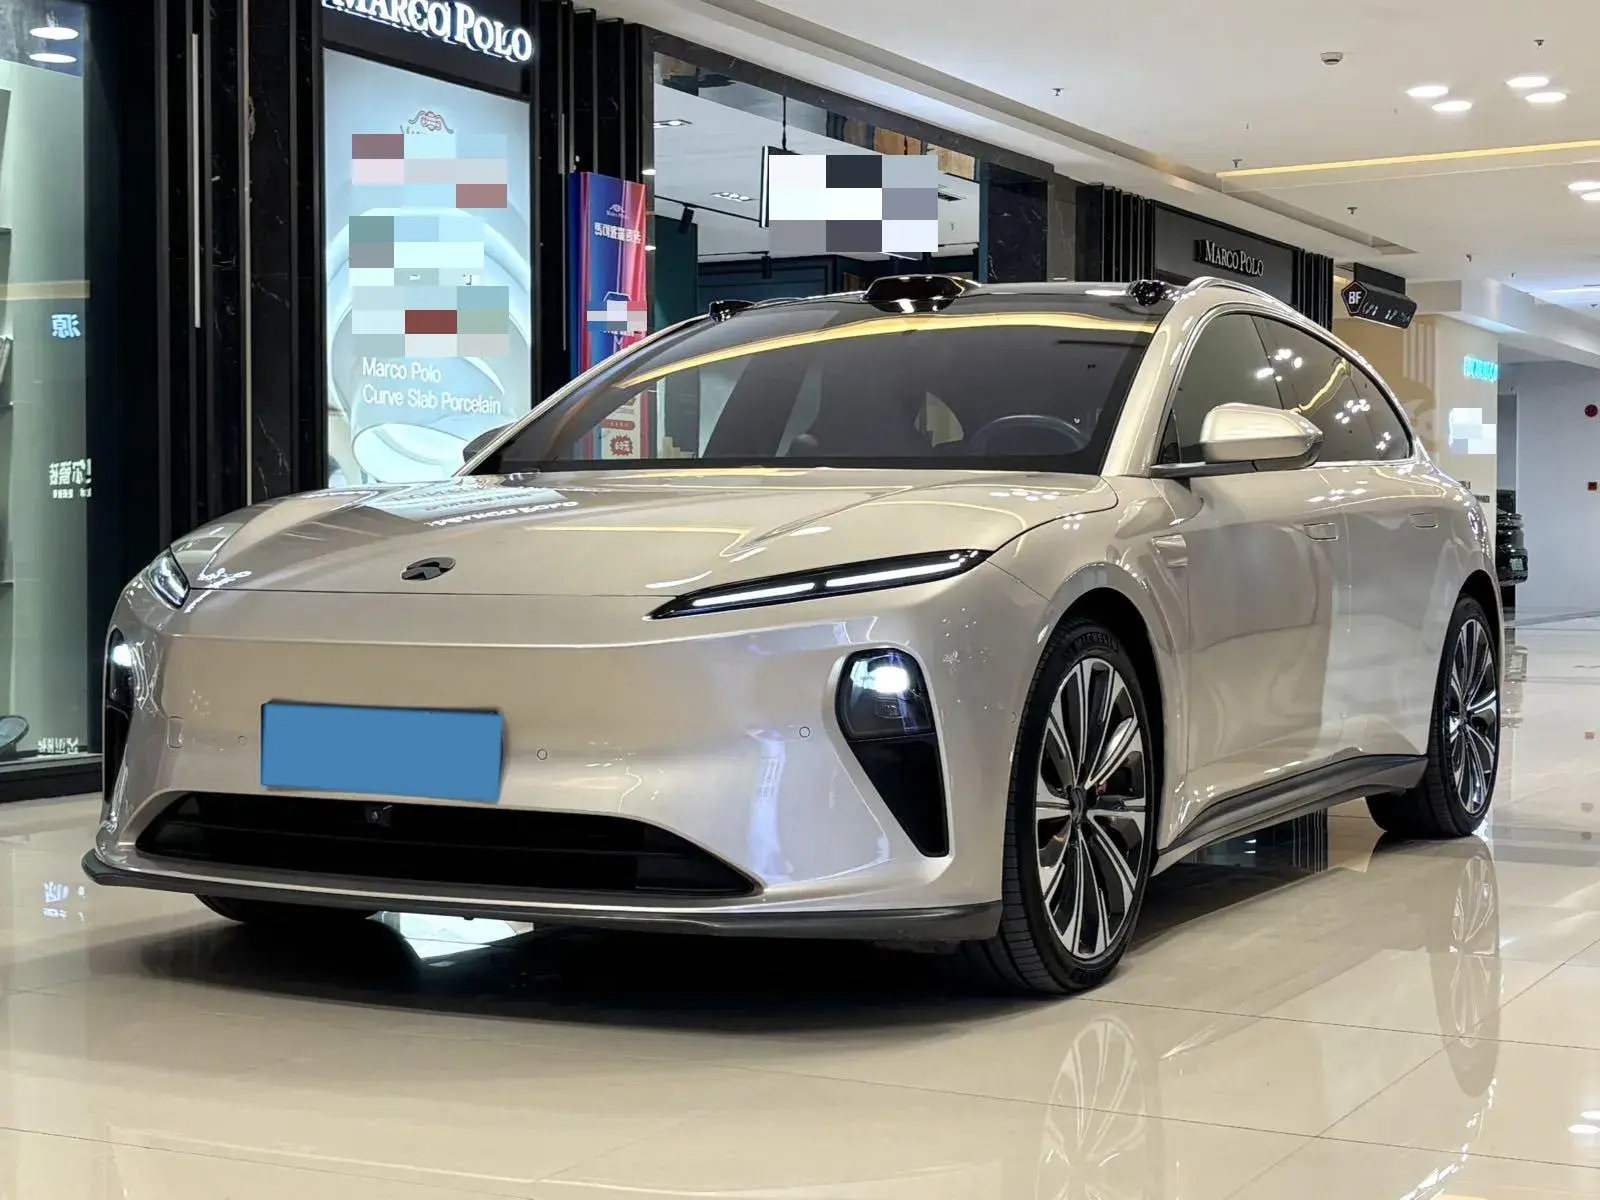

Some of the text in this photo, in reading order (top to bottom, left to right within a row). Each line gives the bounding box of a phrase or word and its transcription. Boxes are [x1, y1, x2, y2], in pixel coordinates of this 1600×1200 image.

[454, 2, 532, 62] POLO
[1205, 240, 1264, 277] MARCO POLO
[1348, 291, 1362, 305] BF
[362, 356, 442, 384] Marco Polo
[362, 383, 502, 415] Curve Slab Porcelain
